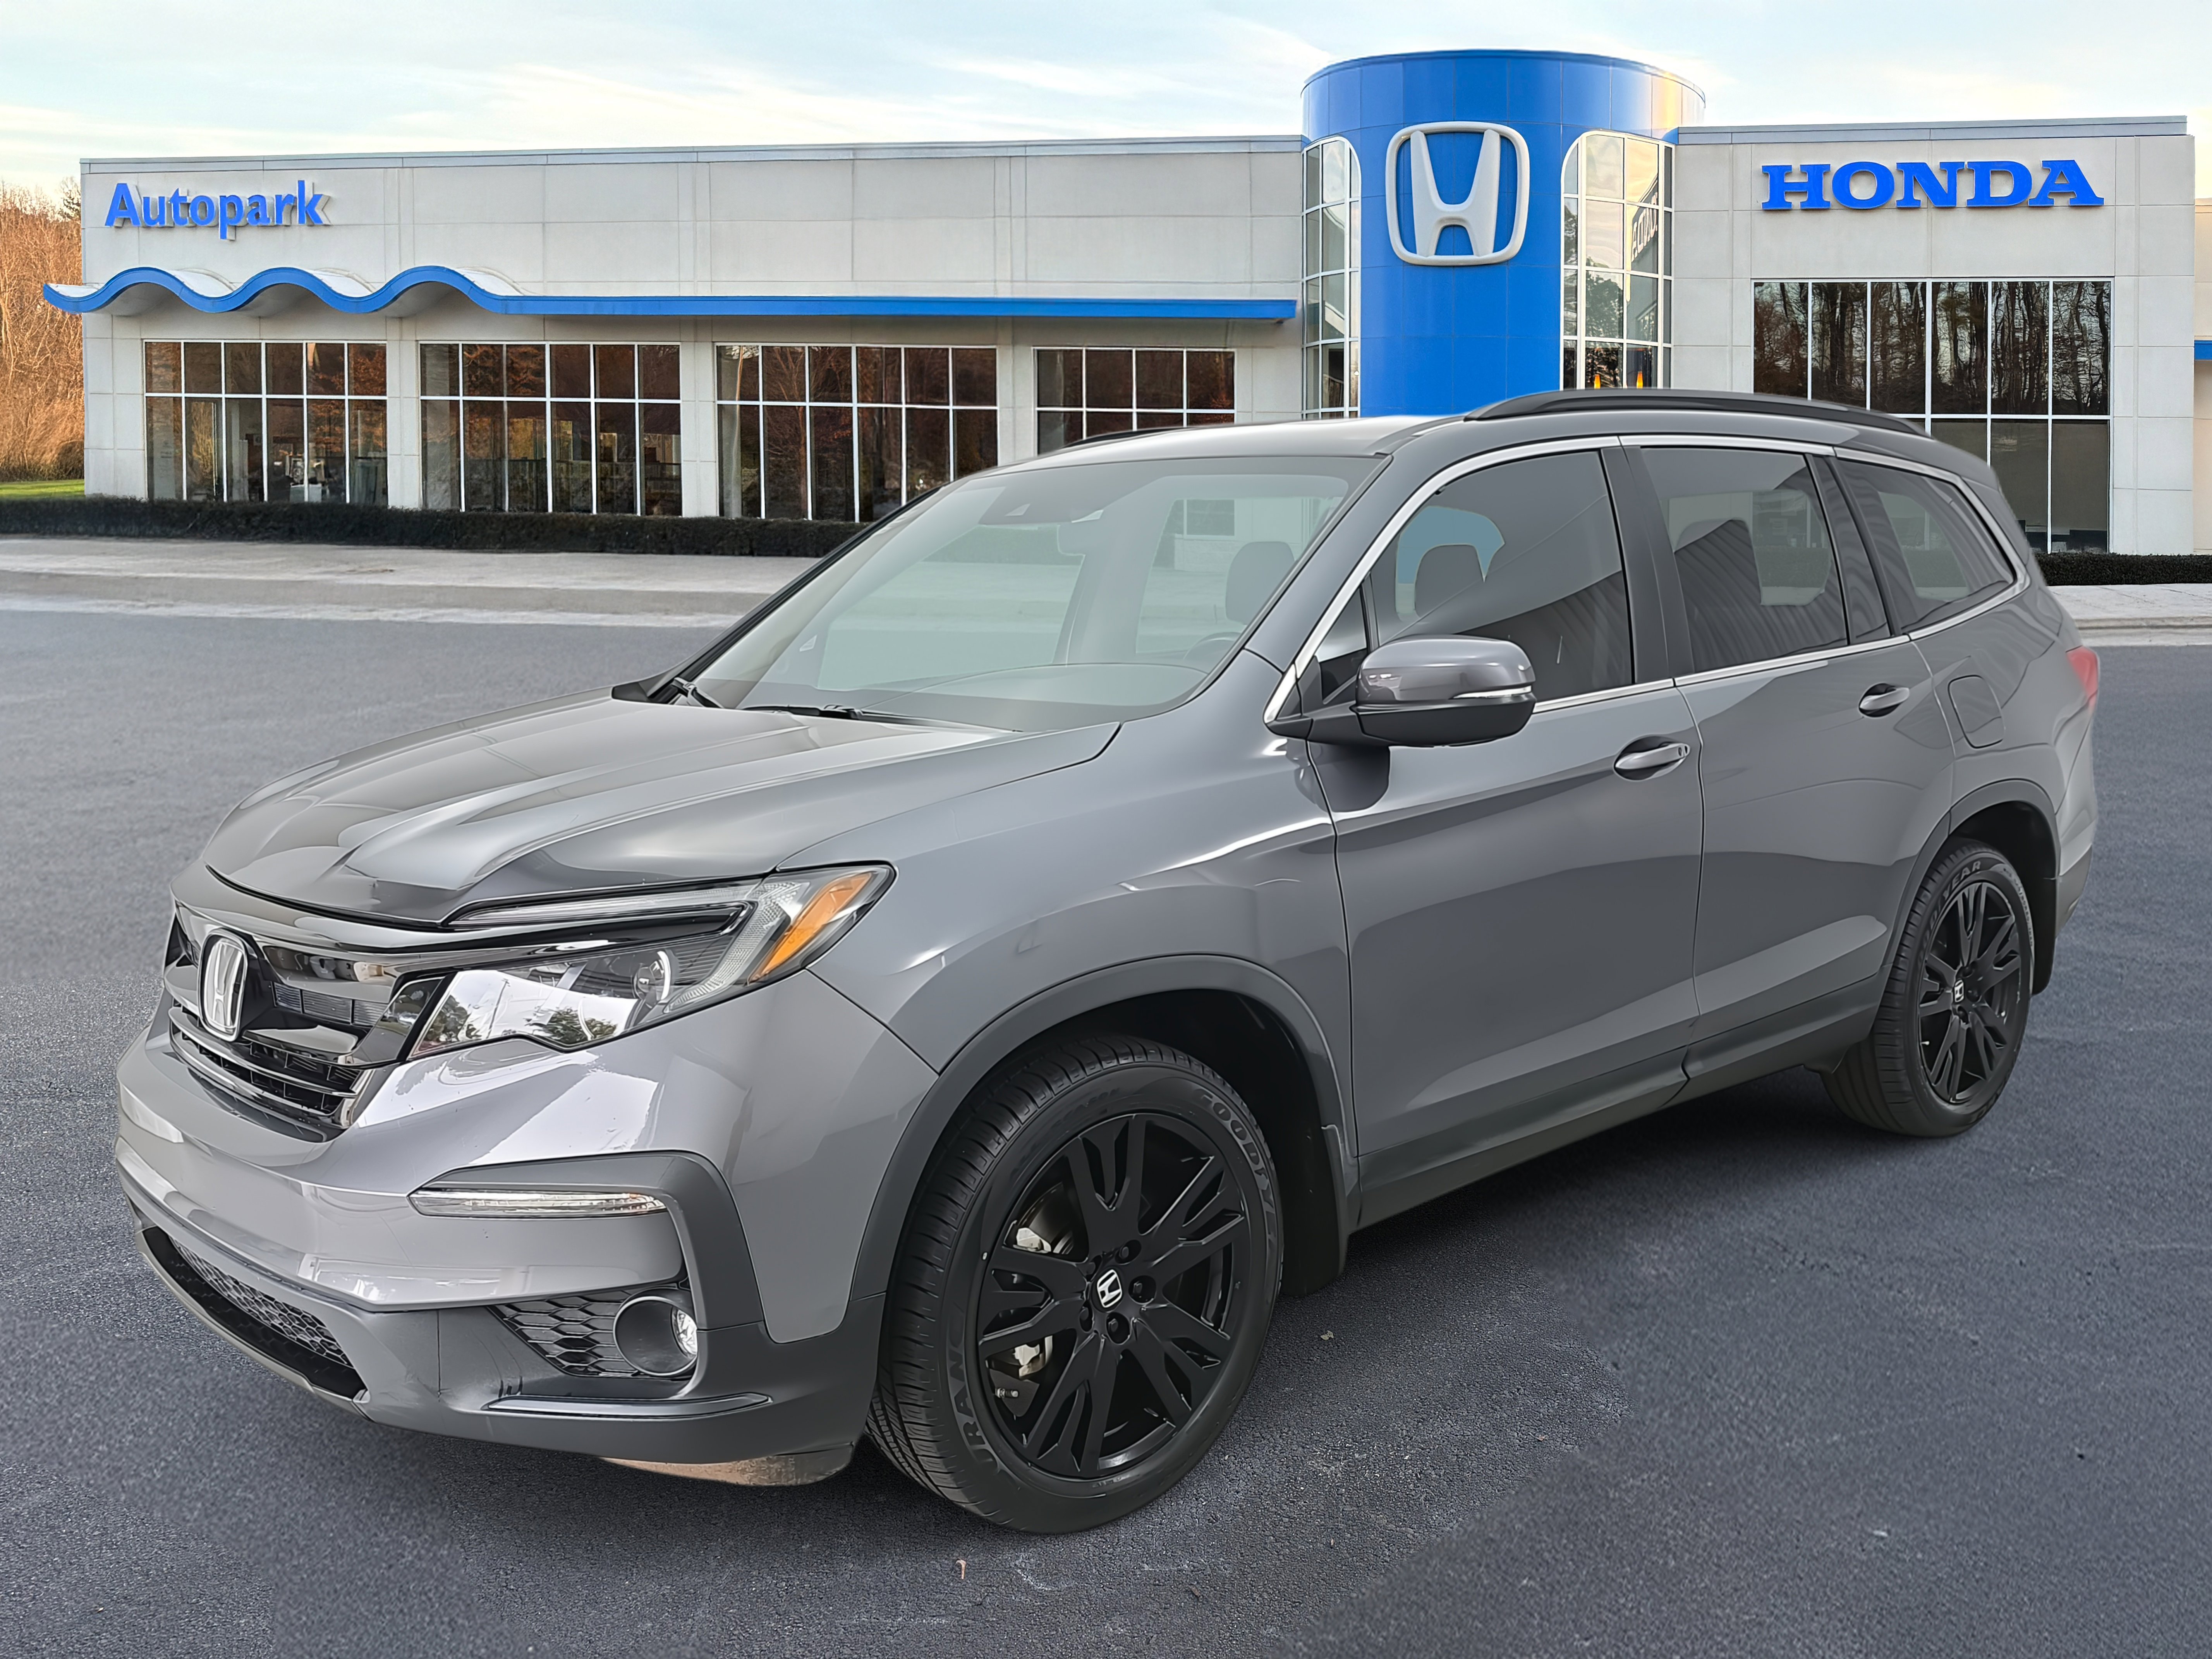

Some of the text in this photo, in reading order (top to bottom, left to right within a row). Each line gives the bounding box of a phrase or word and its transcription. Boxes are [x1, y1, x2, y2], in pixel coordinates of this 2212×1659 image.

[105, 179, 328, 240] Autopark
[1761, 159, 2105, 210] HONDA
[1194, 1085, 1278, 1274] OODYE
